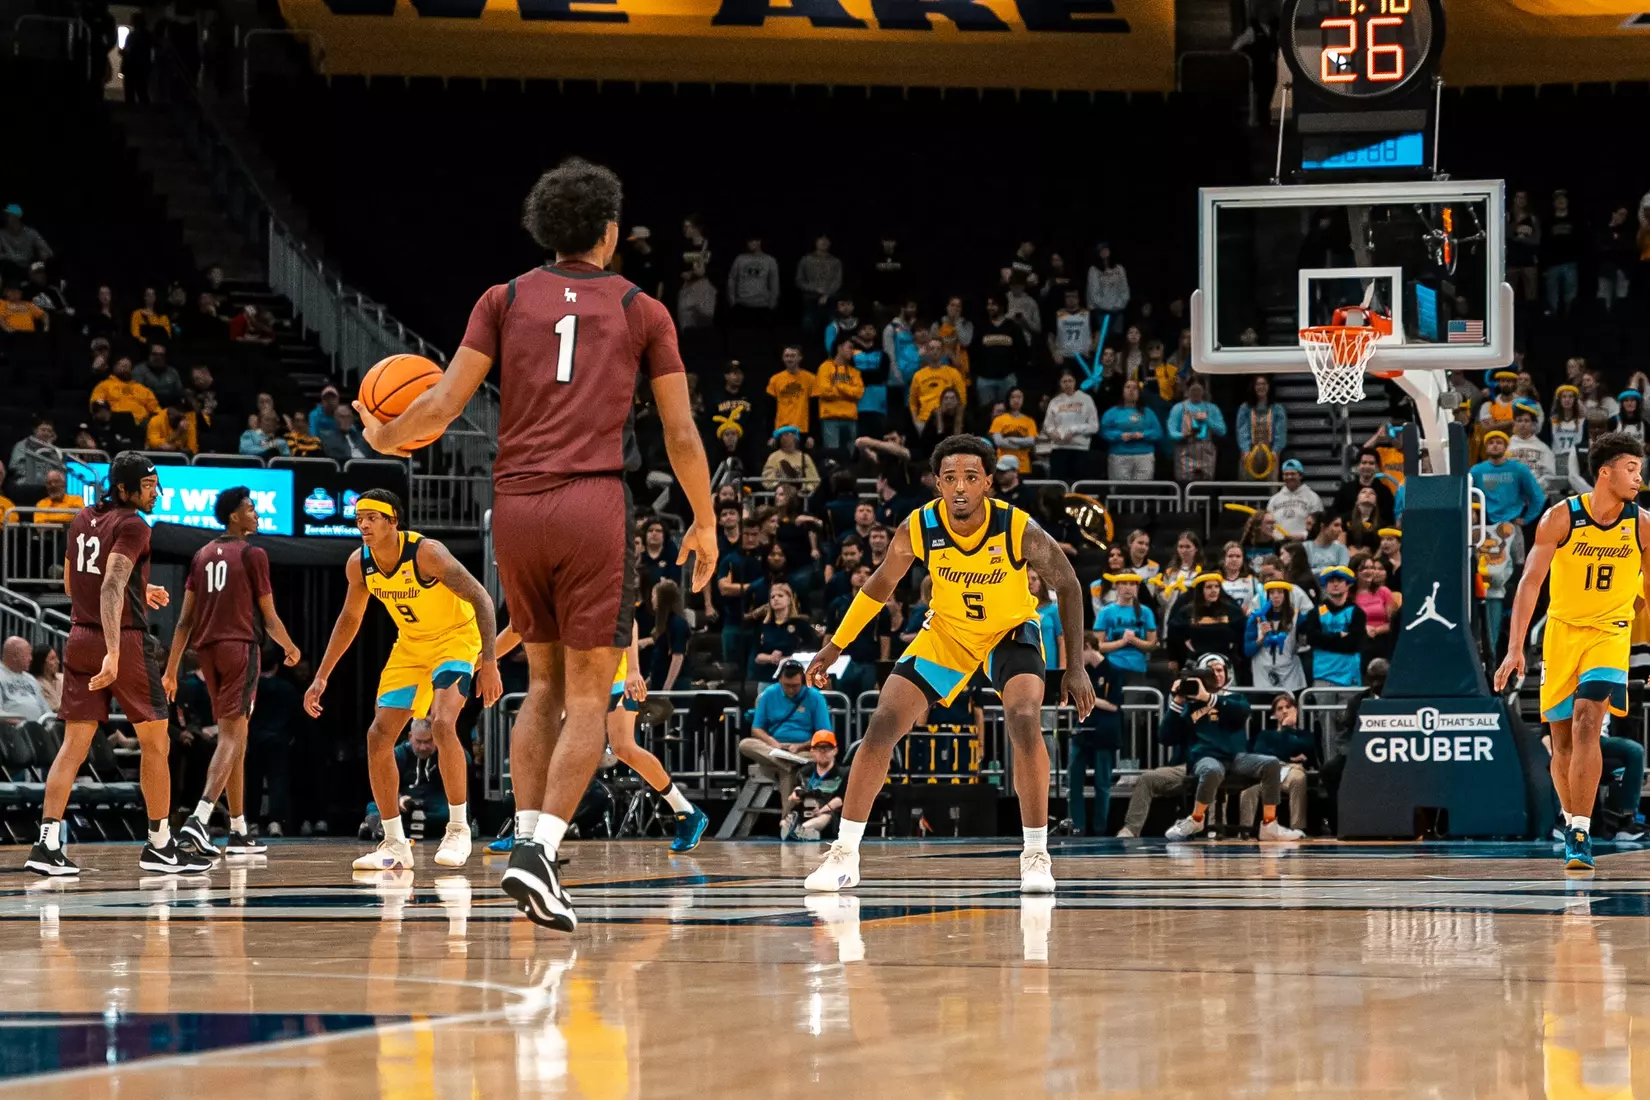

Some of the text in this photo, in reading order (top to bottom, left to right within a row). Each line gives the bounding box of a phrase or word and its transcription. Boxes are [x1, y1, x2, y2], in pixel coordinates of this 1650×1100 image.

[1320, 17, 1405, 83] 26
[554, 314, 579, 384] 1
[180, 487, 277, 513] WK
[76, 533, 102, 575] 12
[1572, 542, 1634, 561] Marquette
[205, 560, 228, 593] 10
[936, 566, 1008, 588] Marquette
[1584, 563, 1615, 591] 18
[372, 587, 421, 602] Marquette
[962, 592, 988, 621] 5
[395, 604, 420, 623] 9
[1365, 718, 1415, 728] ONE CALL
[1421, 710, 1435, 730] G
[1440, 717, 1496, 727] THAT'S ALL
[1364, 736, 1494, 763] GRUBER
